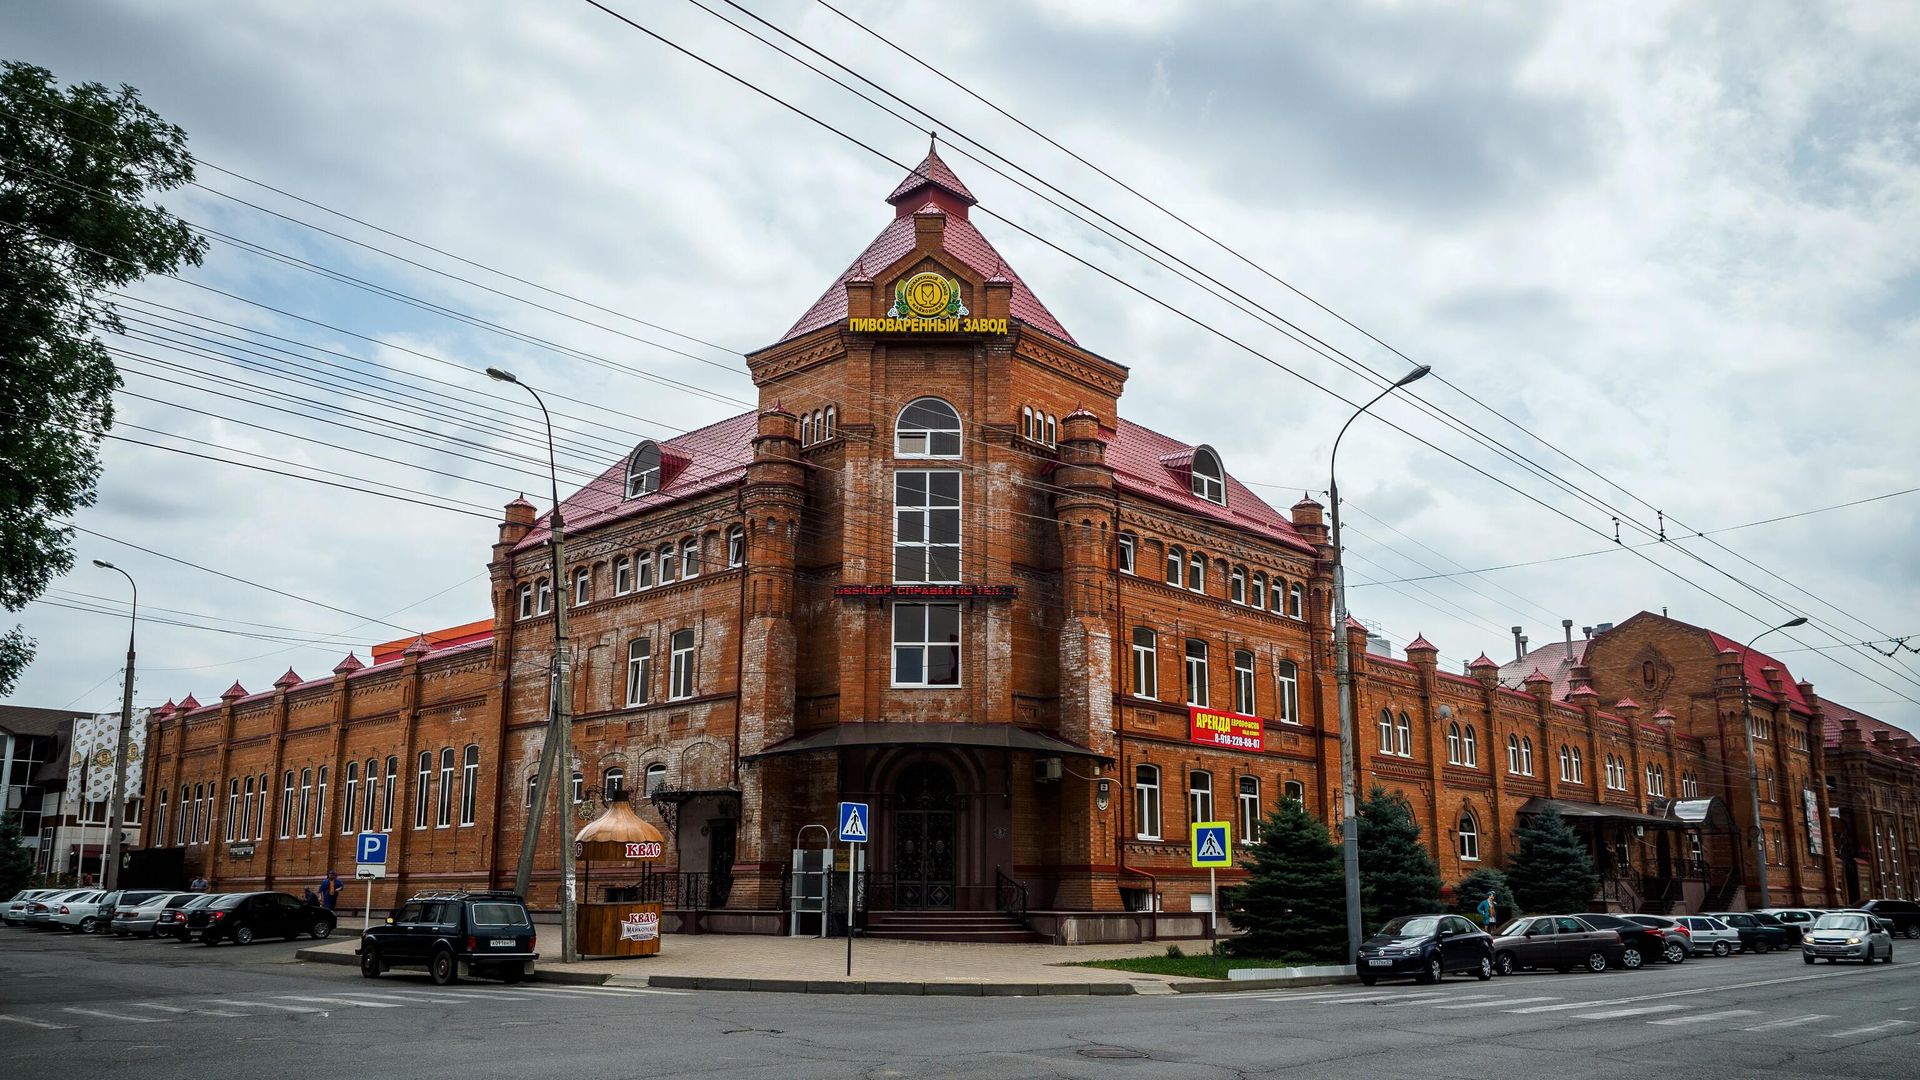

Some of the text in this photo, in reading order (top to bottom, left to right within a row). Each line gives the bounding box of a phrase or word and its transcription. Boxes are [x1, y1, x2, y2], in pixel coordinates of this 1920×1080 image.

[850, 316, 1008, 334] ПИВОВАРЕННЫЙ ЗАВОД
[897, 585, 953, 595] СПРАВКИ
[1196, 712, 1231, 733] АРЕНДА
[363, 836, 381, 860] P
[626, 843, 660, 857] КВАС
[629, 912, 657, 923] КВАС
